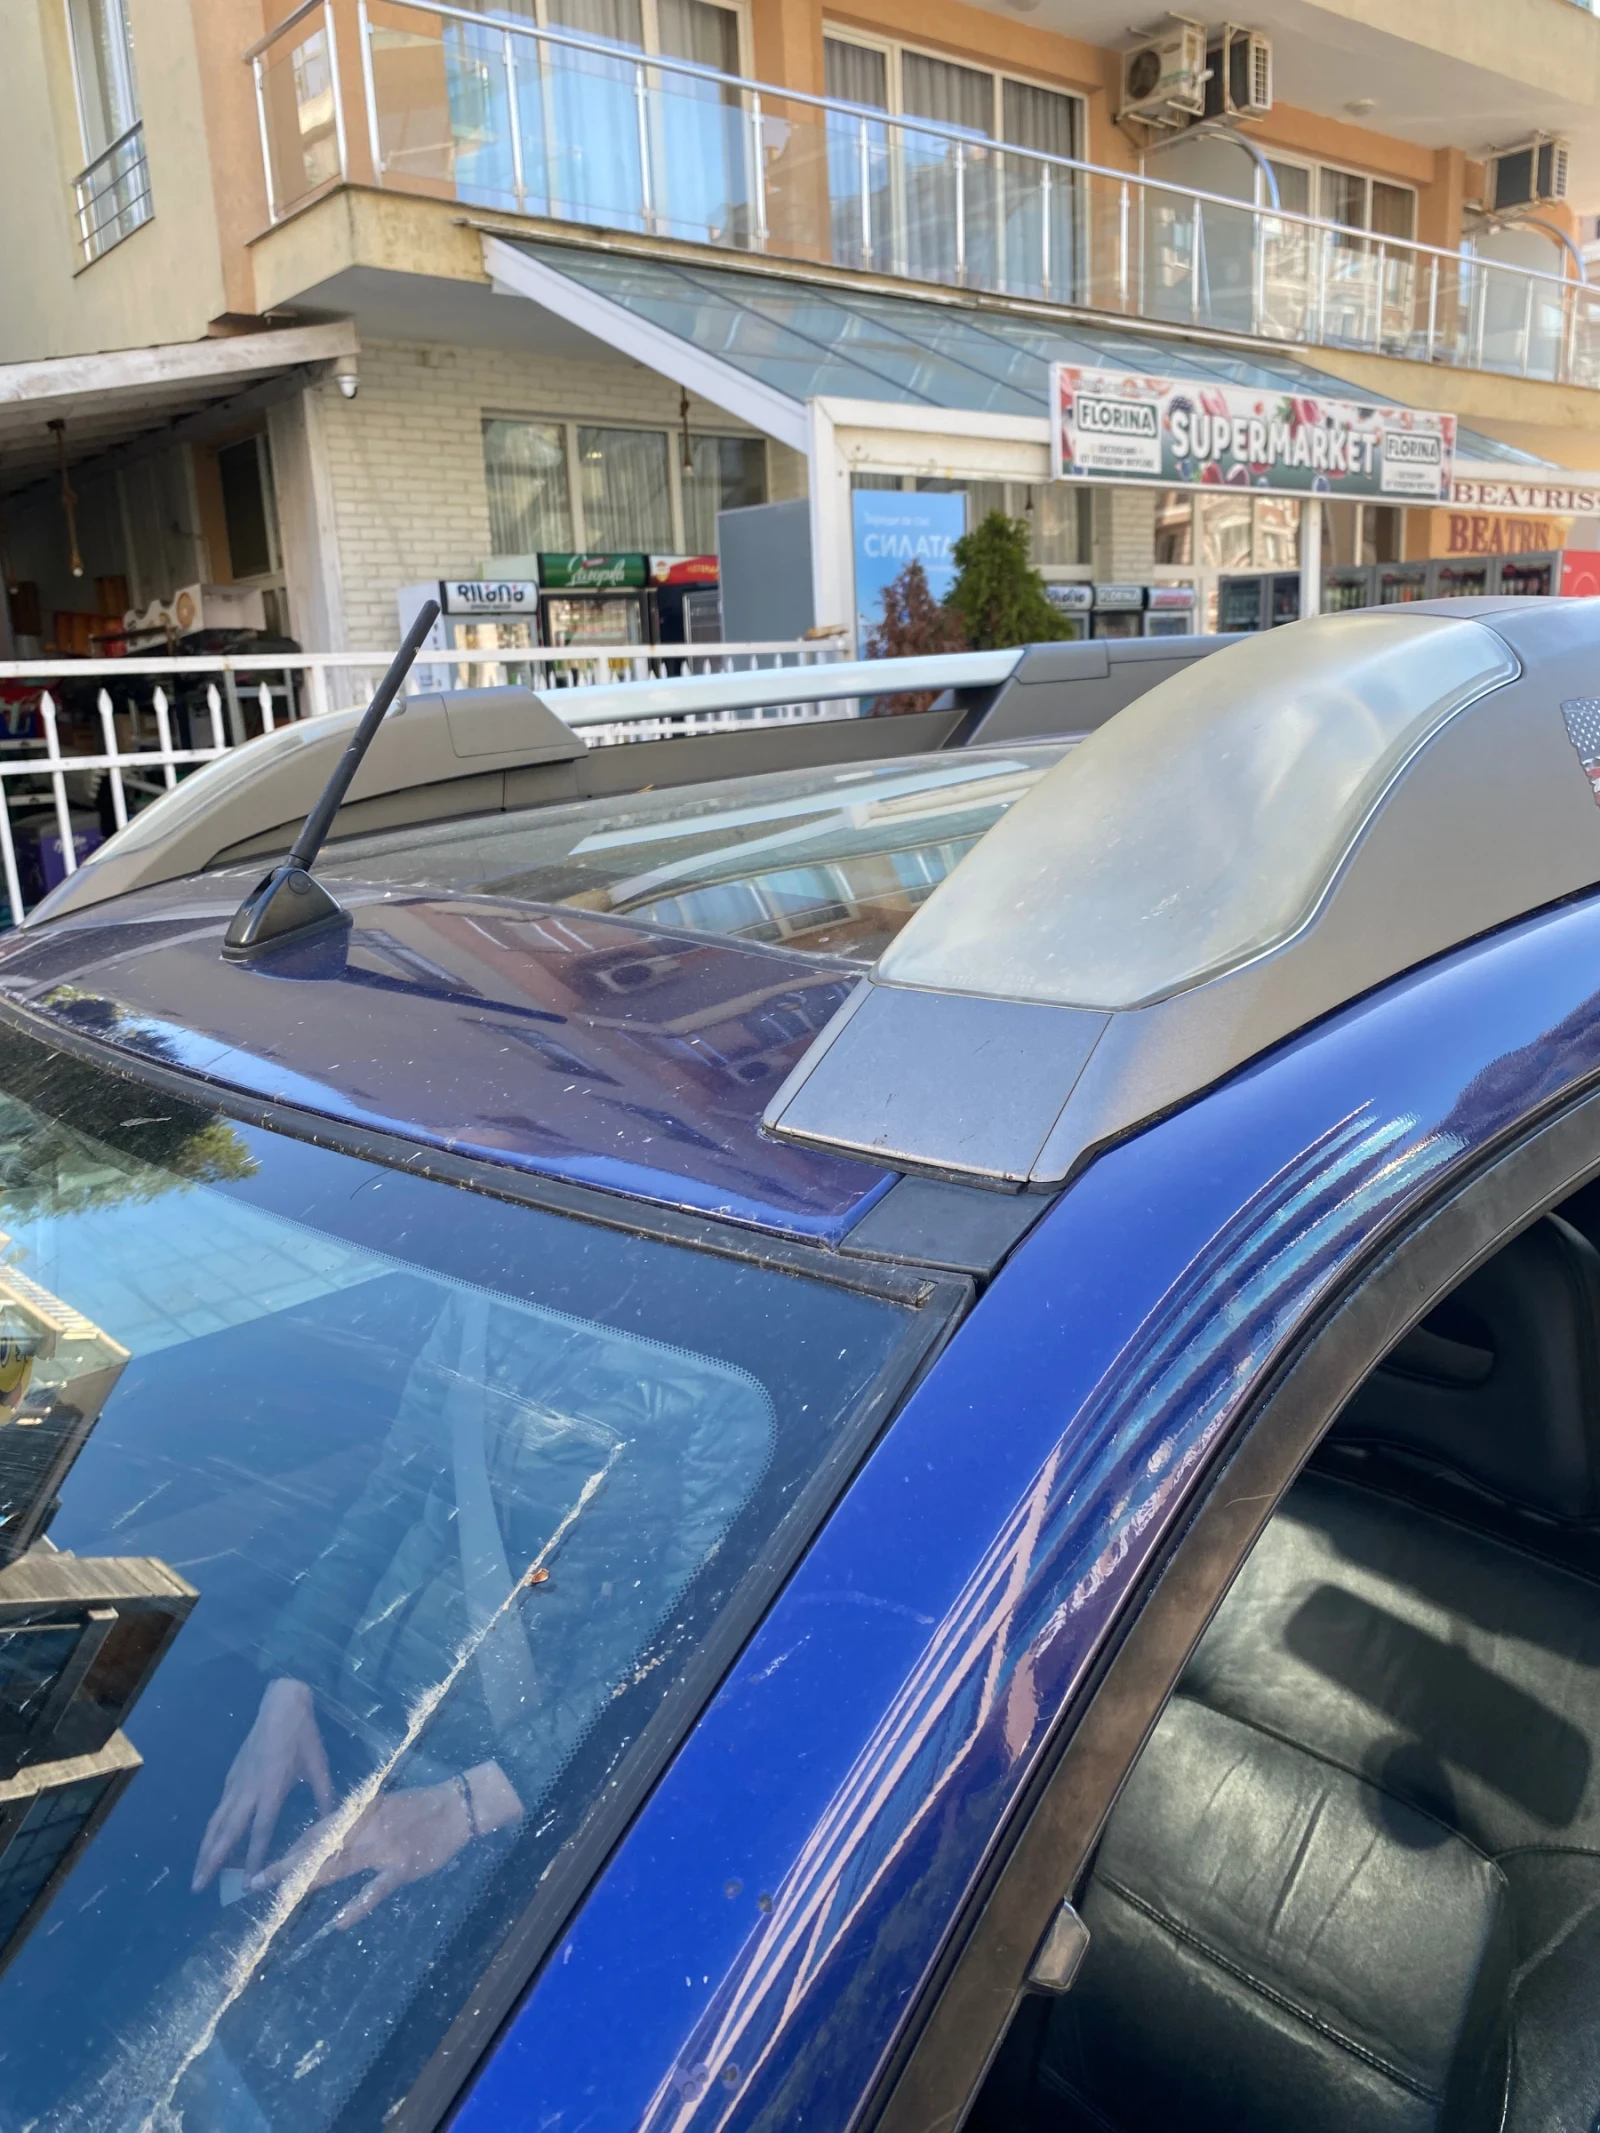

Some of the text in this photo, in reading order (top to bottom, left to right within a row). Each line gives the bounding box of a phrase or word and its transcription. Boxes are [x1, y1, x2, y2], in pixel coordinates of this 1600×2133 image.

[1081, 403, 1153, 432] FLORINA
[1170, 410, 1378, 474] SUPERMARKET
[1387, 437, 1438, 460] FLORINA
[1453, 482, 1600, 512] BEATRIS
[1447, 513, 1551, 555] BEATRIS
